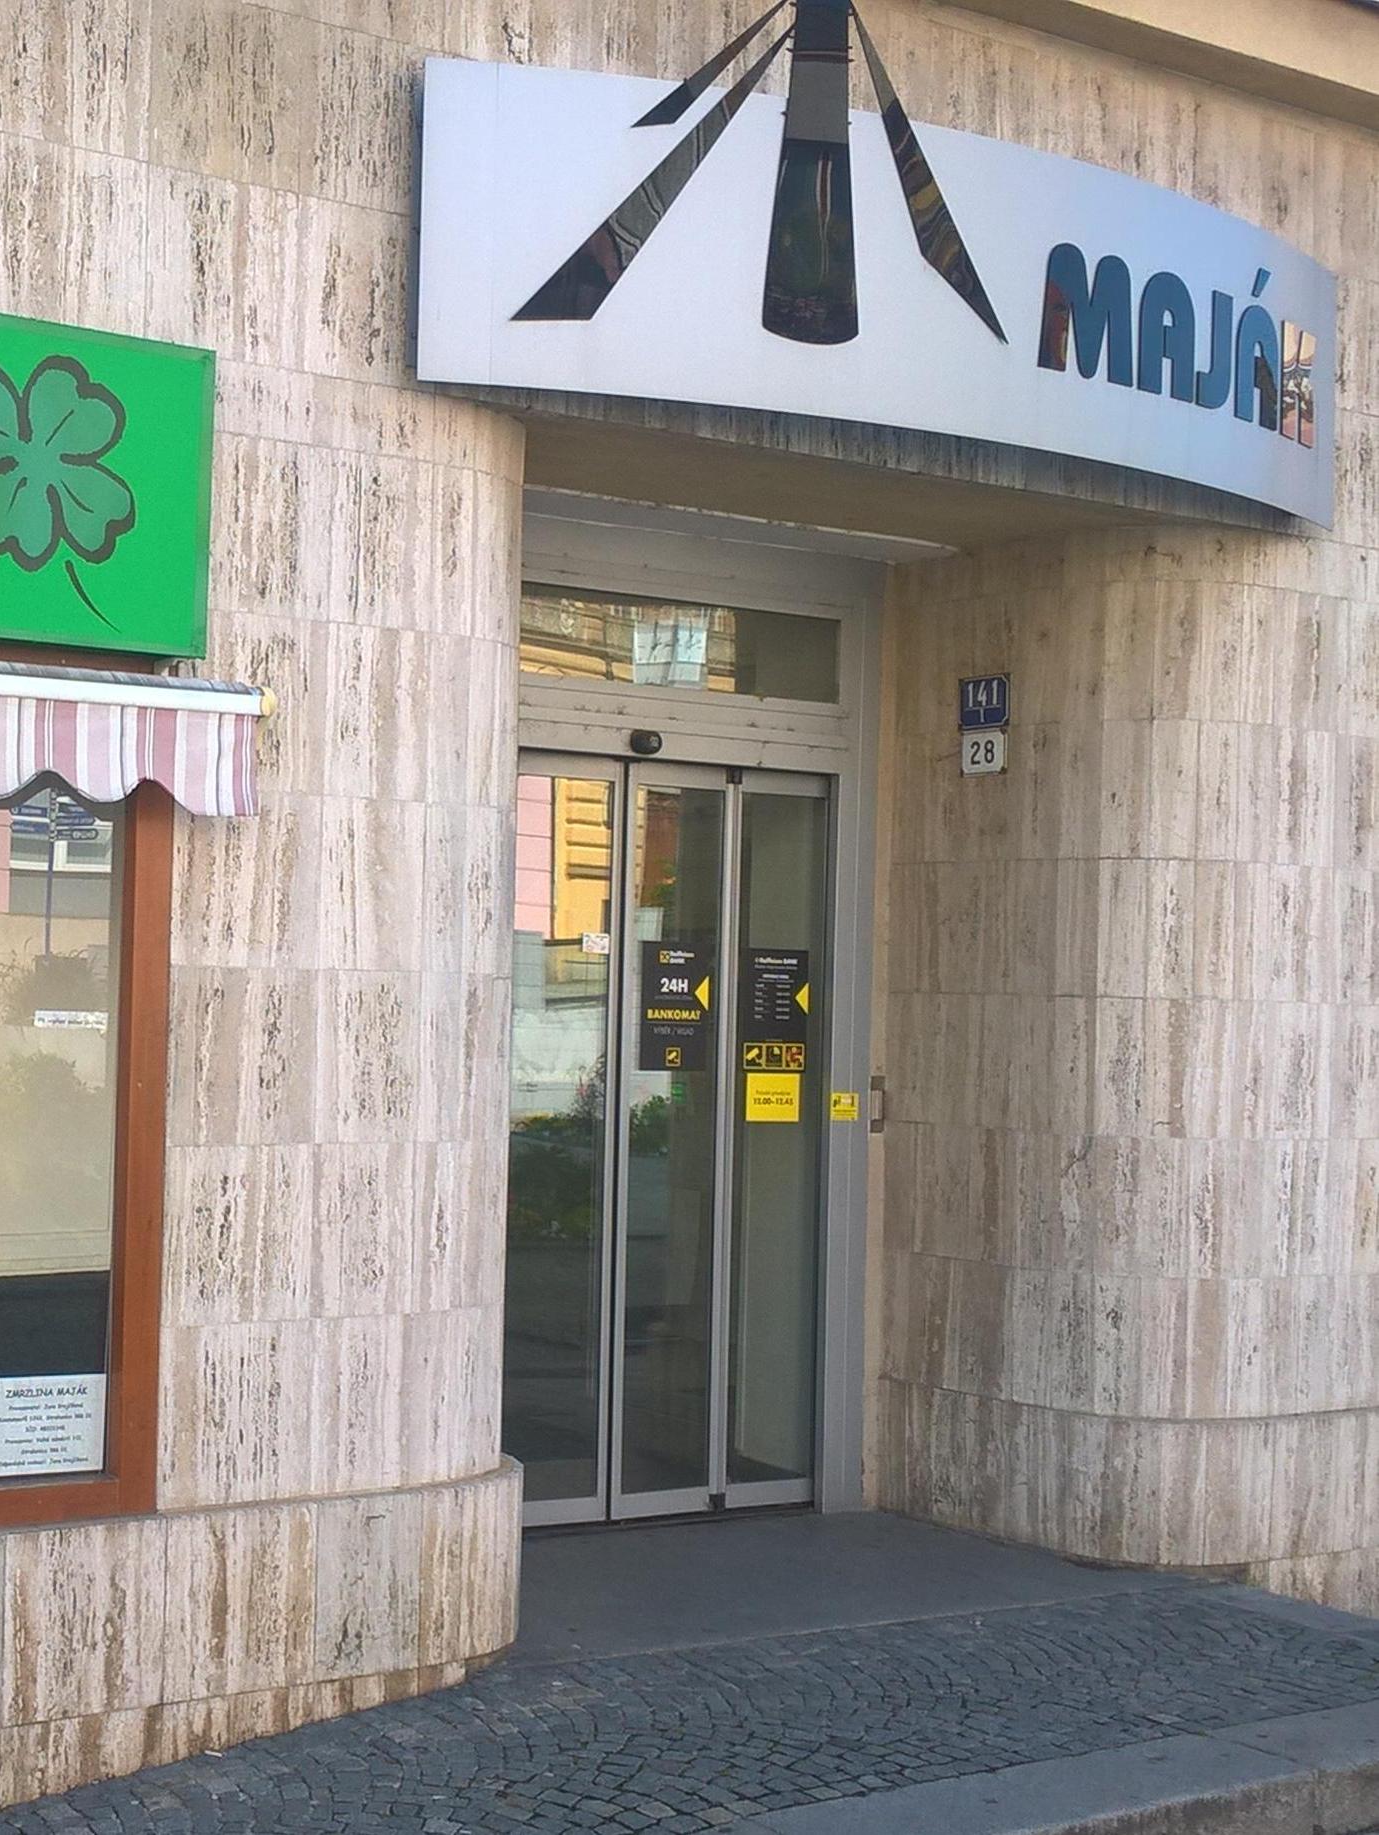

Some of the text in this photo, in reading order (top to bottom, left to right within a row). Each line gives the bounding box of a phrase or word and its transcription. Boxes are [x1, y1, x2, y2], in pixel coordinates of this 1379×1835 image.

[1037, 243, 1316, 449] MAJÁK
[967, 679, 999, 707] 141
[970, 740, 995, 765] 28
[660, 978, 689, 993] 24H
[647, 1009, 701, 1020] BANKOMAT
[5, 1384, 88, 1398] ZMRZLINA MAJÁK
